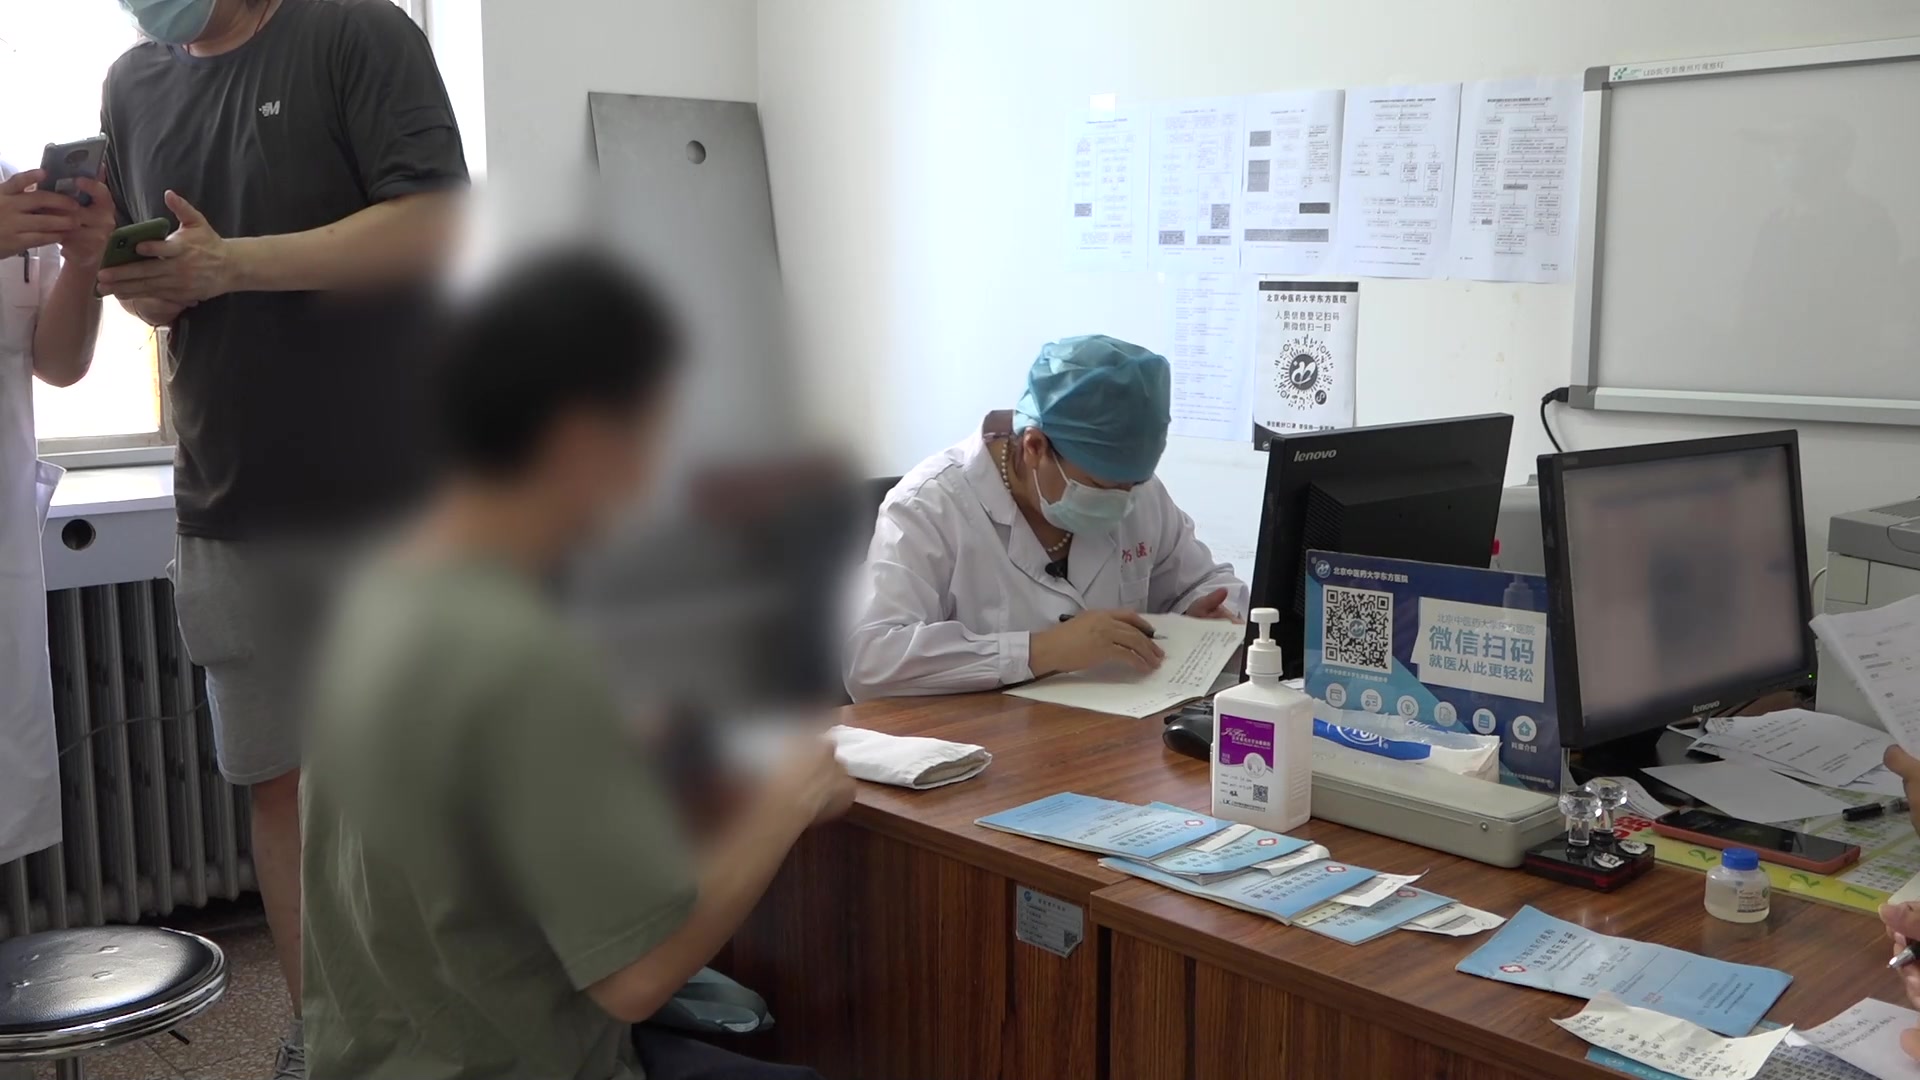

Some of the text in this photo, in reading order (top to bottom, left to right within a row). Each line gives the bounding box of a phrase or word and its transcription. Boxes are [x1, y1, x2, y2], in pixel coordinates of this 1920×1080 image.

[1266, 293, 1347, 304] 北京中医药大学东方医院
[1275, 310, 1340, 321] 人员信息登记扫码
[1282, 322, 1331, 332] 用微信扫一扫
[1293, 449, 1337, 462] lenovo
[1333, 566, 1408, 583] 北京中医药大学东方医院
[1437, 613, 1536, 636] 北京中医药大学东方医院
[1429, 625, 1534, 665] 微信扫码
[1429, 653, 1534, 683] 就医从此更轻松
[1692, 700, 1721, 714] lenovo
